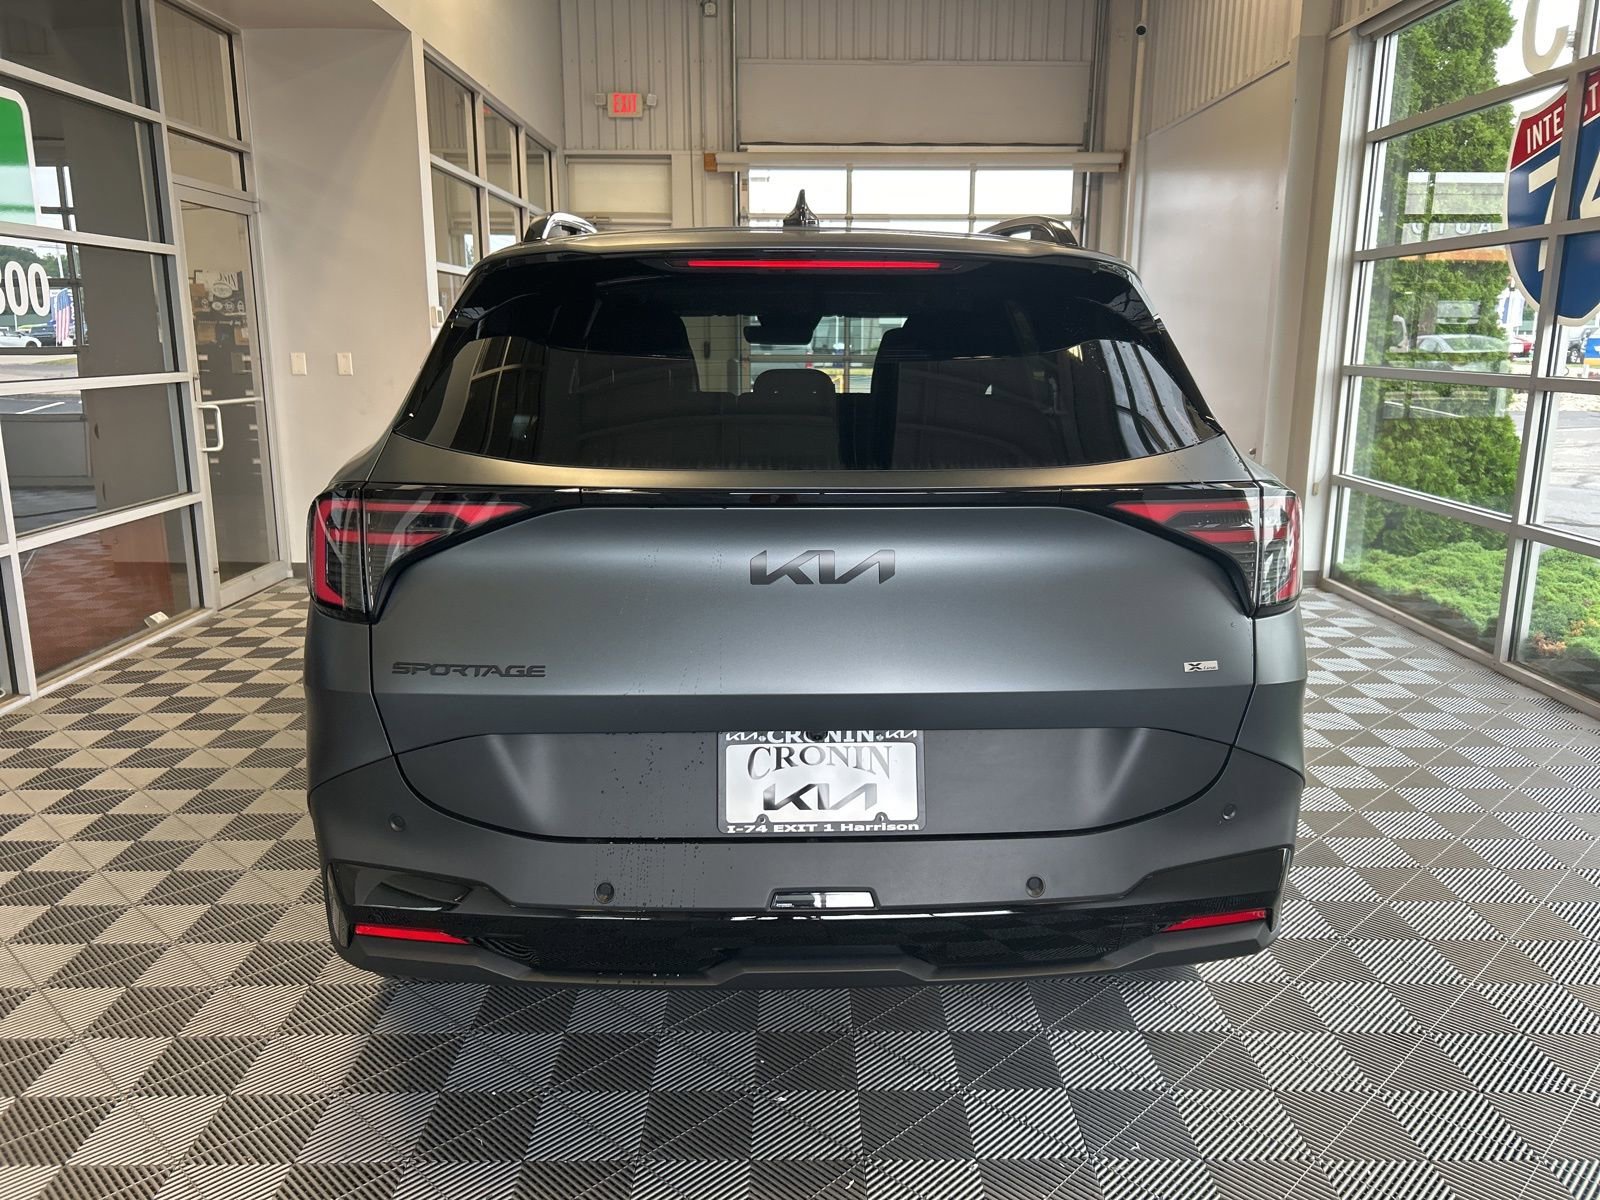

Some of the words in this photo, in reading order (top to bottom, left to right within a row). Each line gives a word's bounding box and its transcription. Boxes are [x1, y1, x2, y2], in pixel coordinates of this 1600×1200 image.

[613, 94, 637, 113] EXIT
[750, 549, 896, 585] KIA
[391, 661, 547, 678] SPORTAGE
[747, 745, 893, 780] CRONIN
[763, 782, 878, 811] KIA
[727, 824, 768, 834] I-74
[773, 823, 818, 833] EXIT
[823, 823, 834, 832] 1
[840, 822, 919, 832] Harrison
